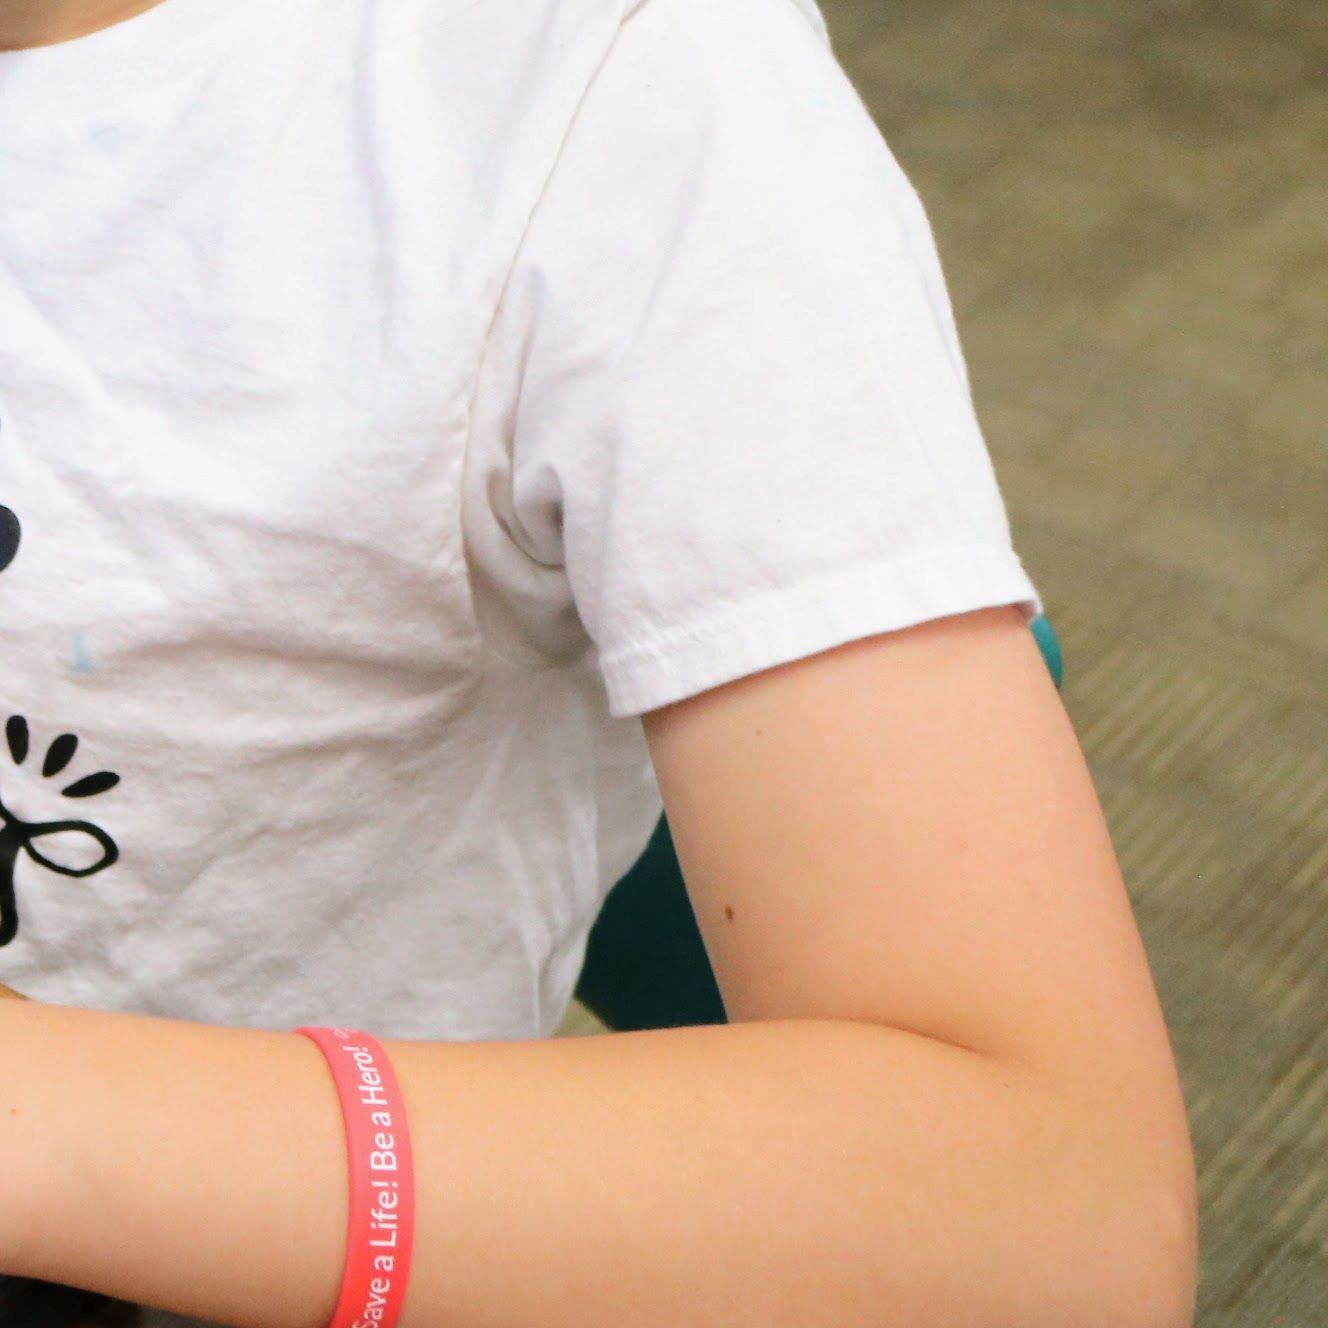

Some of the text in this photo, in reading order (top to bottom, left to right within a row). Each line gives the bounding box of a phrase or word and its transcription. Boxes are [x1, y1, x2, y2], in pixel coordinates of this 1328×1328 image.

[342, 1045, 389, 1106] Hero!
[370, 1111, 392, 1127] a
[370, 1132, 397, 1171] Be
[369, 1180, 400, 1248] Life!
[373, 1255, 394, 1272] a
